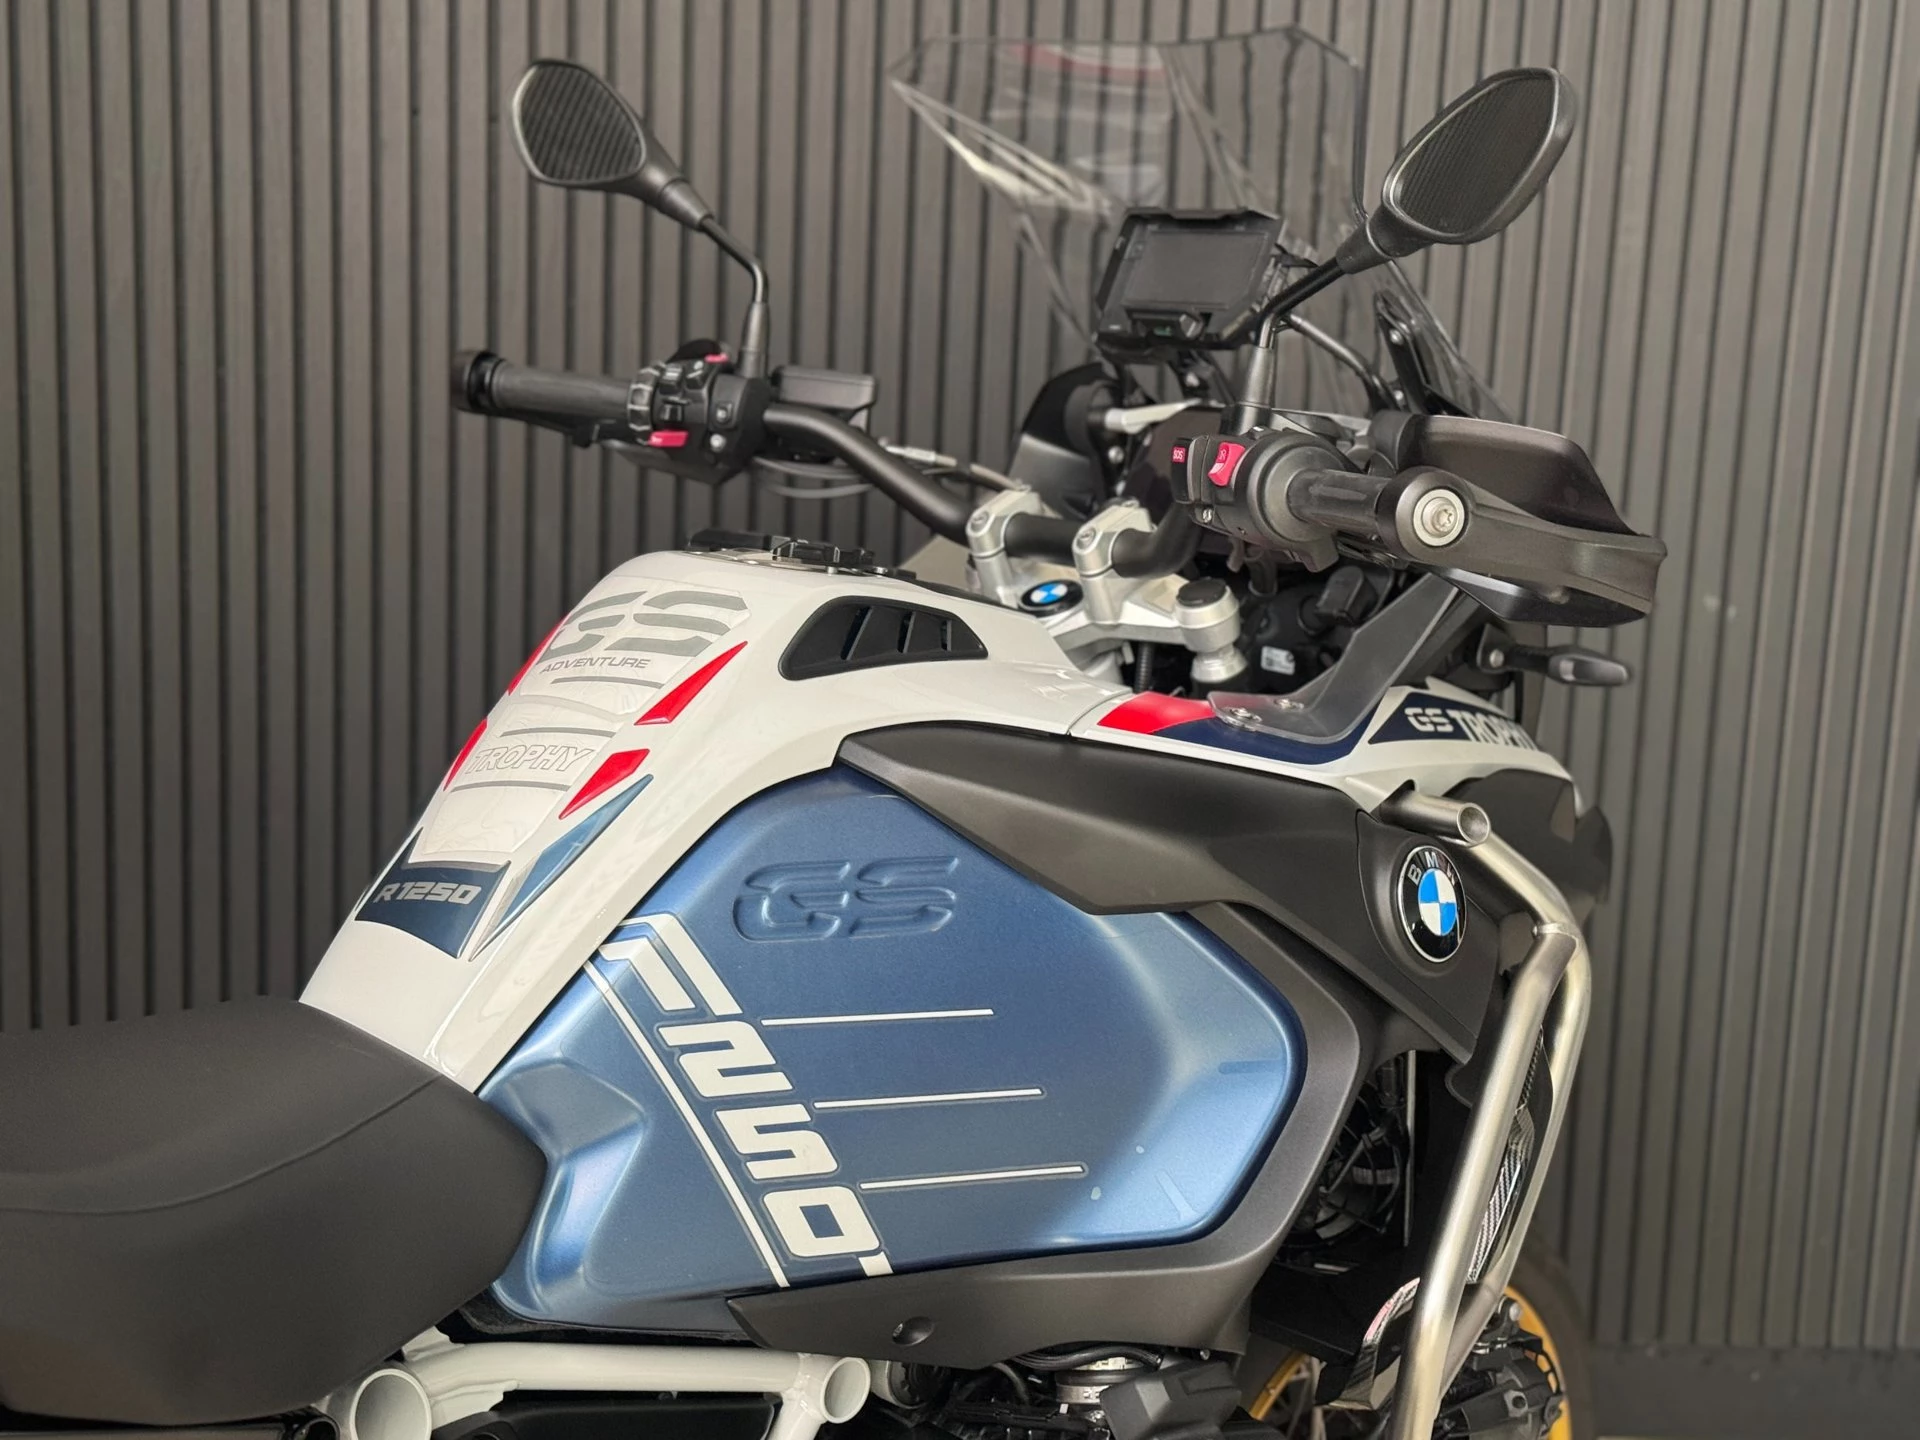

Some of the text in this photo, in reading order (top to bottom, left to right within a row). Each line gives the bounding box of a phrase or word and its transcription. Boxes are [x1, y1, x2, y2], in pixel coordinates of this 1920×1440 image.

[1173, 449, 1184, 460] SOS
[535, 590, 748, 666] GS
[538, 655, 651, 675] ADVENTURE
[1404, 706, 1540, 751] GS TROPH
[464, 744, 595, 775] TROPHY
[732, 855, 960, 943] GS
